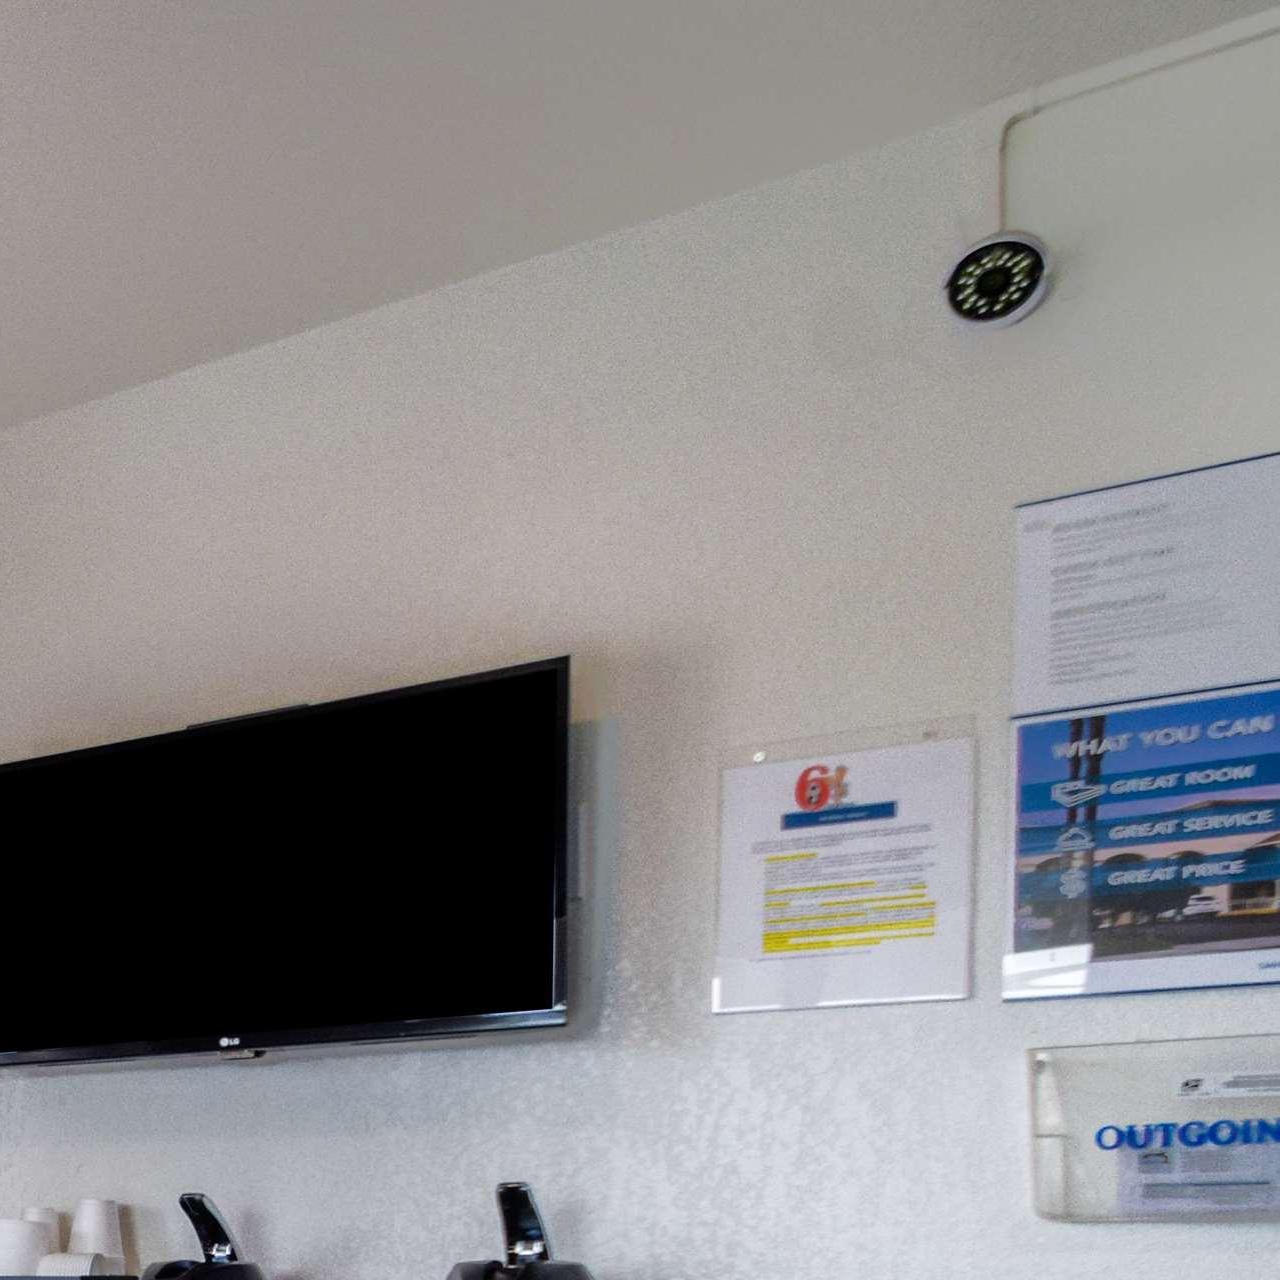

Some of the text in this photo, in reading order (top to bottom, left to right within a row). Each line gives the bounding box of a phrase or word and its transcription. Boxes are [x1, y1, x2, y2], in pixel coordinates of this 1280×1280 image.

[1051, 715, 1276, 759] WHAT YOU CAN
[1109, 764, 1257, 795] GREAT ROOM
[1109, 809, 1274, 840] GREAT SERVICE
[1107, 859, 1247, 886] GREAT PRICE
